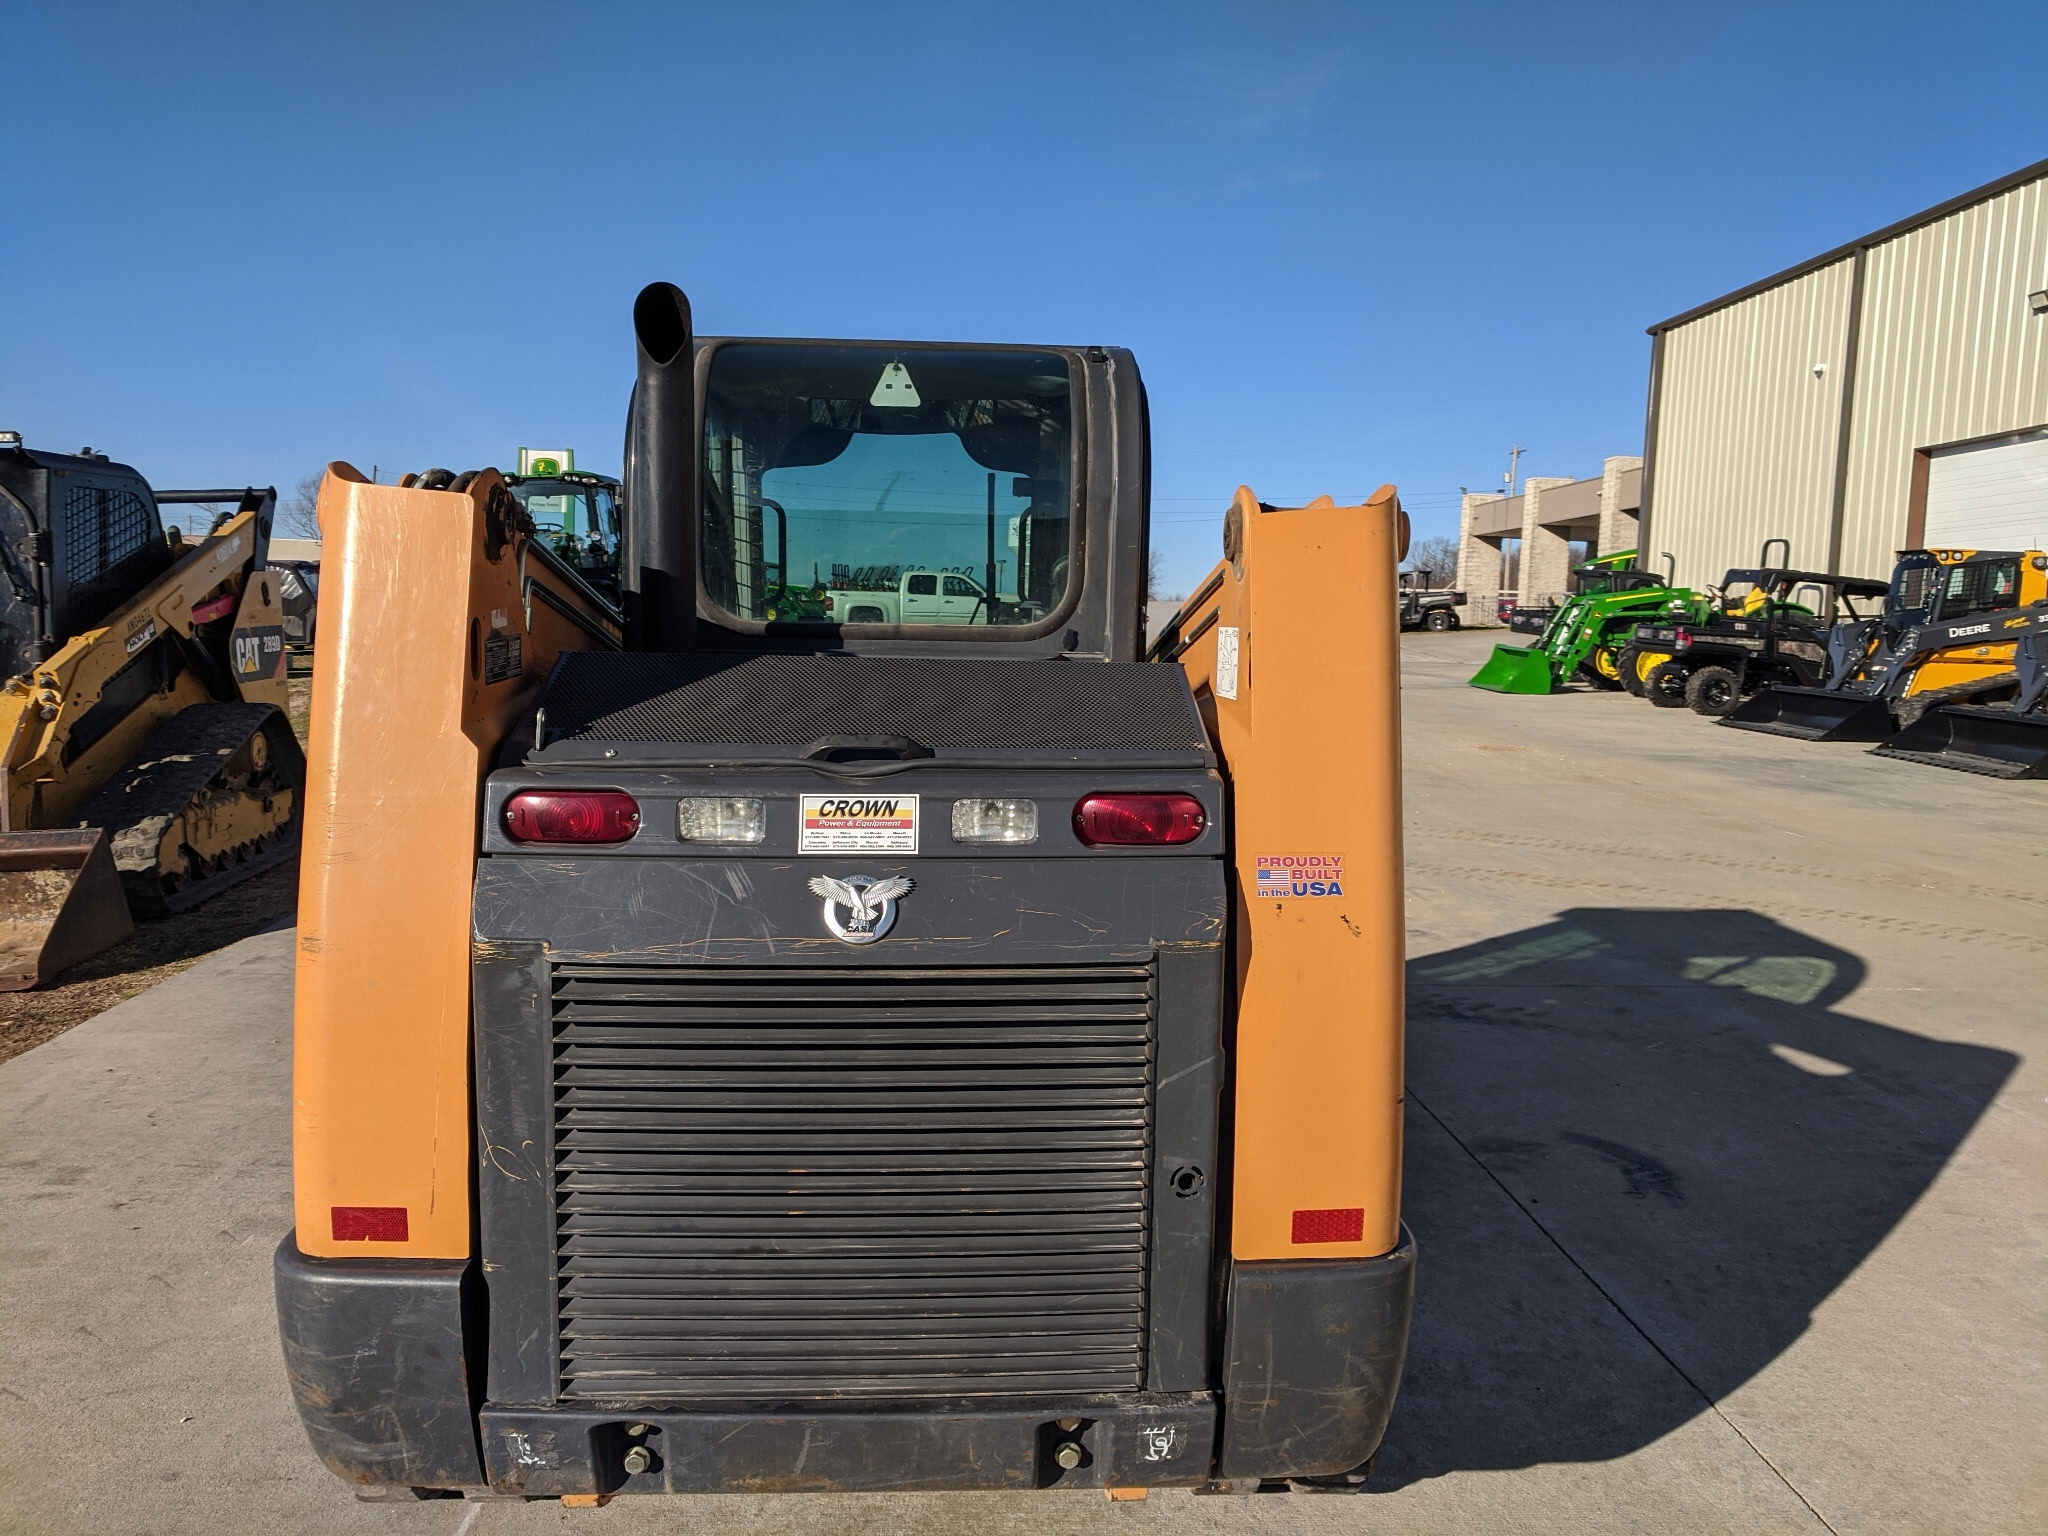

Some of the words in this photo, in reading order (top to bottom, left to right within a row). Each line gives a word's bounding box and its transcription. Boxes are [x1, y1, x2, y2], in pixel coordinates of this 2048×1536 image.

[1949, 623, 1991, 638] DEERE
[263, 635, 281, 653] 289D
[236, 636, 260, 673] CAT
[819, 799, 899, 817] CROWN
[818, 819, 845, 827] Power
[846, 819, 854, 827] &
[855, 819, 902, 828] Equipment
[1257, 856, 1342, 868] PROUDLY
[1291, 869, 1343, 880] BUILT
[1257, 888, 1269, 897] in
[1271, 888, 1291, 897] the
[1292, 881, 1343, 897] USA
